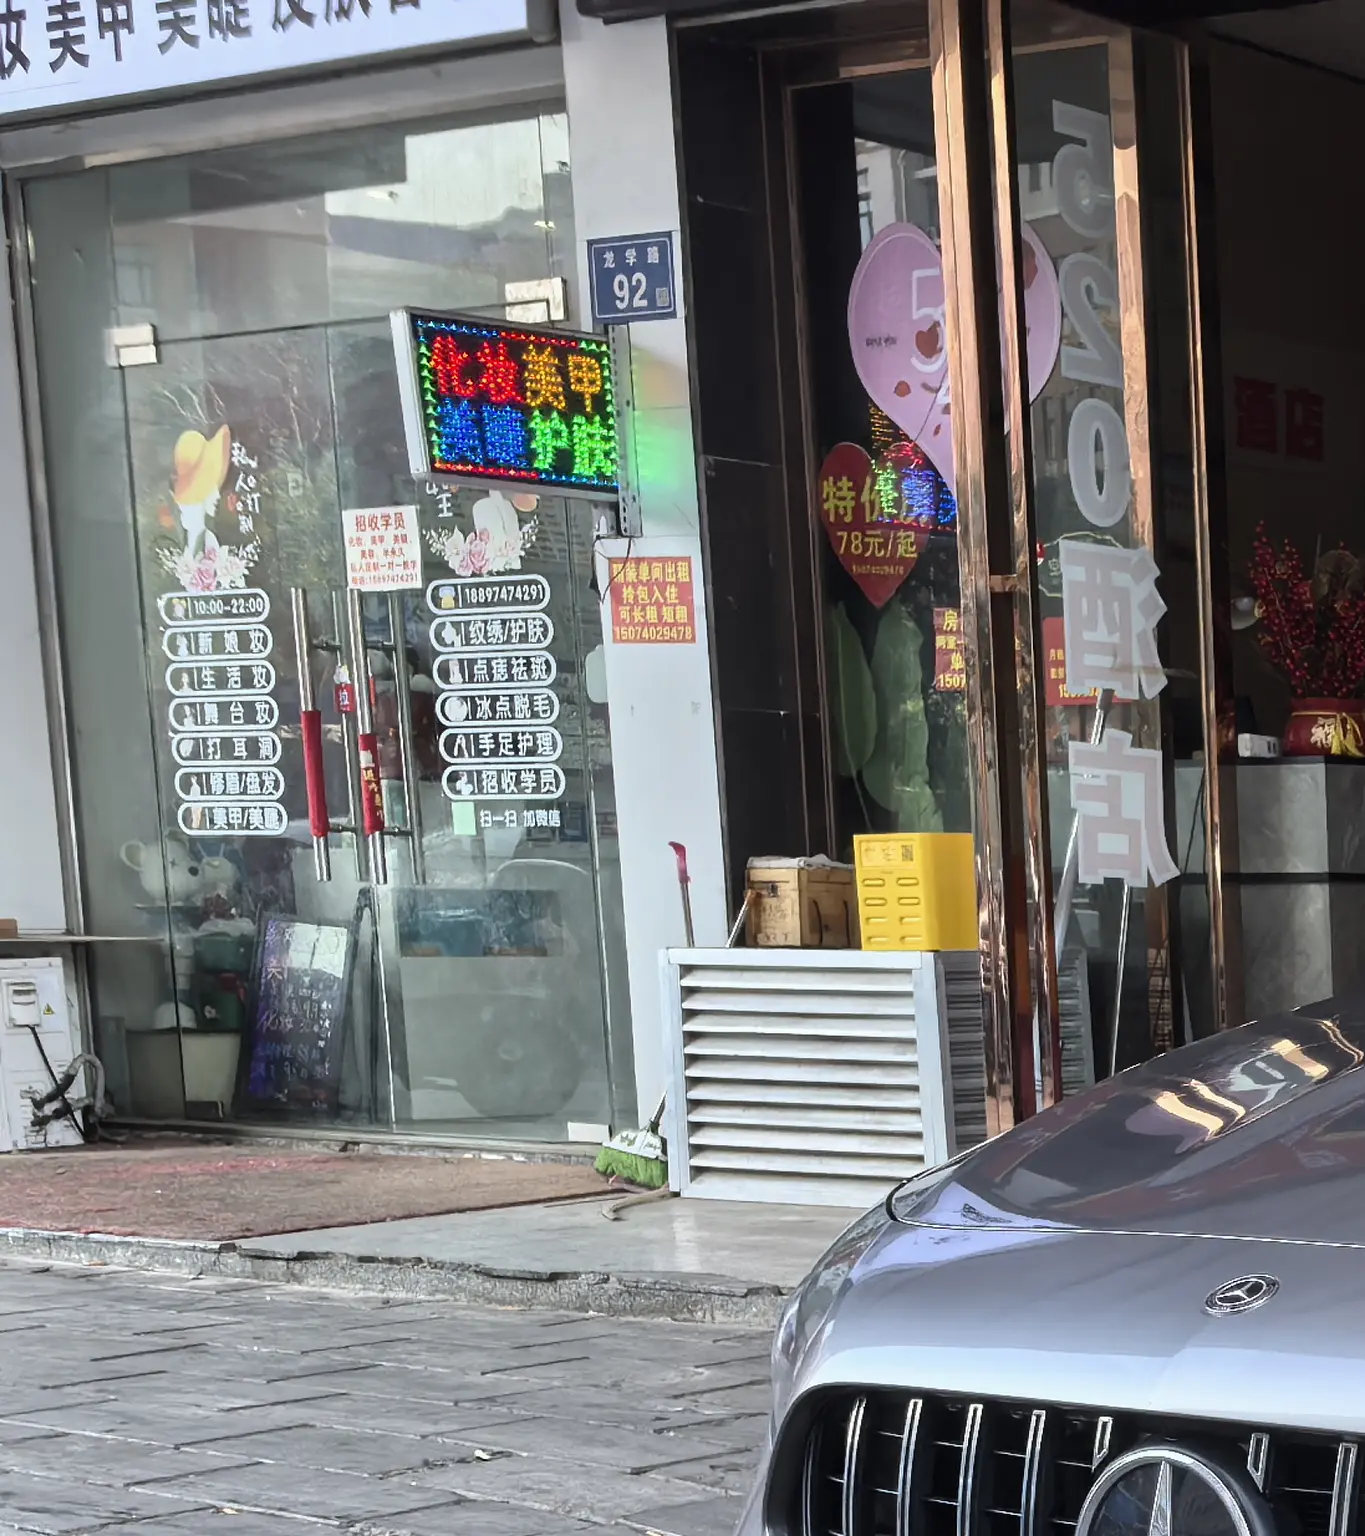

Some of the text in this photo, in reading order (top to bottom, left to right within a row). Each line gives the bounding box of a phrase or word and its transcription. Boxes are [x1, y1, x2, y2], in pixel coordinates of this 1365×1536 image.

[603, 246, 659, 269] 龙学路
[613, 272, 648, 310] 92
[355, 512, 406, 533] 招收学员
[836, 530, 918, 559] 78元/起
[464, 584, 543, 605] 18897474291
[193, 599, 264, 615] 10:00-22:00
[198, 630, 265, 654] 新娘妆
[468, 621, 545, 646] 纹绣/护肤
[613, 626, 693, 641] 15074029478
[201, 665, 268, 690] 生活妆
[474, 659, 548, 683] 点痣祛斑
[203, 701, 271, 725] 舞台妆
[475, 696, 551, 720] 冰点脱毛
[206, 736, 274, 761] 打耳洞
[478, 733, 554, 758] 手足护理
[482, 770, 557, 795] 招收学员
[480, 809, 517, 828] 扫一扫
